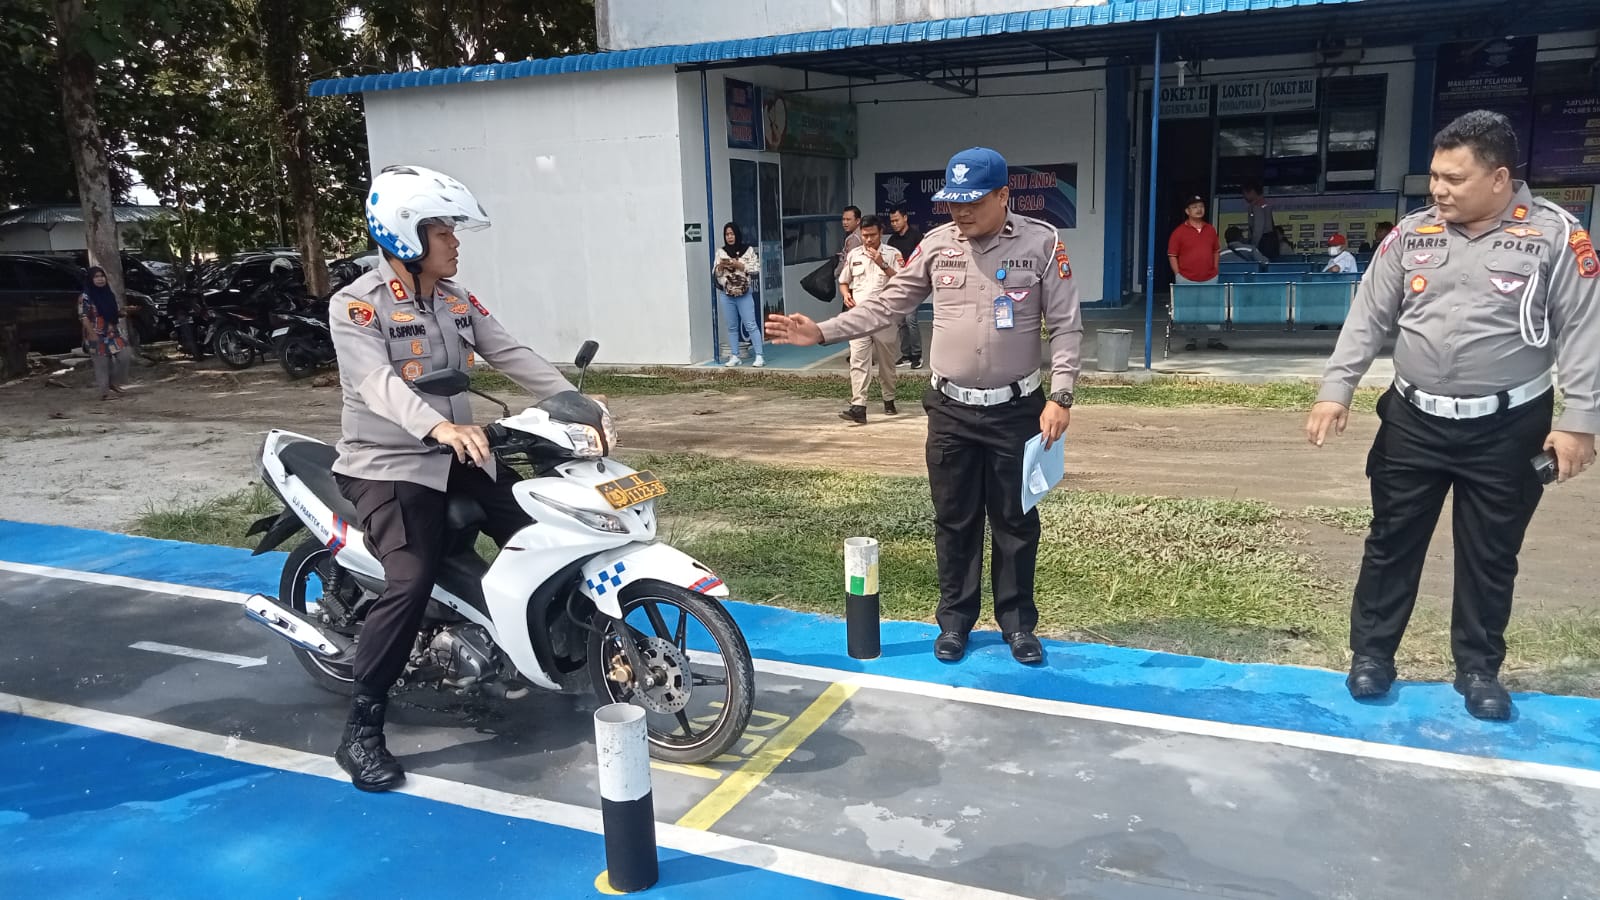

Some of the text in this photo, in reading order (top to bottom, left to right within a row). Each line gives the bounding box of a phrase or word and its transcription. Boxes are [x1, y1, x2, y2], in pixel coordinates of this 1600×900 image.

[1484, 76, 1523, 85] PELAYANAN
[1159, 85, 1209, 101] OKET II
[1222, 84, 1254, 98] LOKET
[1270, 81, 1296, 95] LOKET
[1159, 102, 1208, 115] EGISTRASI
[1009, 172, 1057, 190] SIM ANDA
[1564, 189, 1586, 201] SIM
[1017, 195, 1045, 211] CALO
[1407, 237, 1447, 249] HARIS
[1492, 240, 1541, 254] POLRI
[935, 259, 967, 269] J.DAMANIK
[389, 324, 426, 339] R.SIPAYUNG
